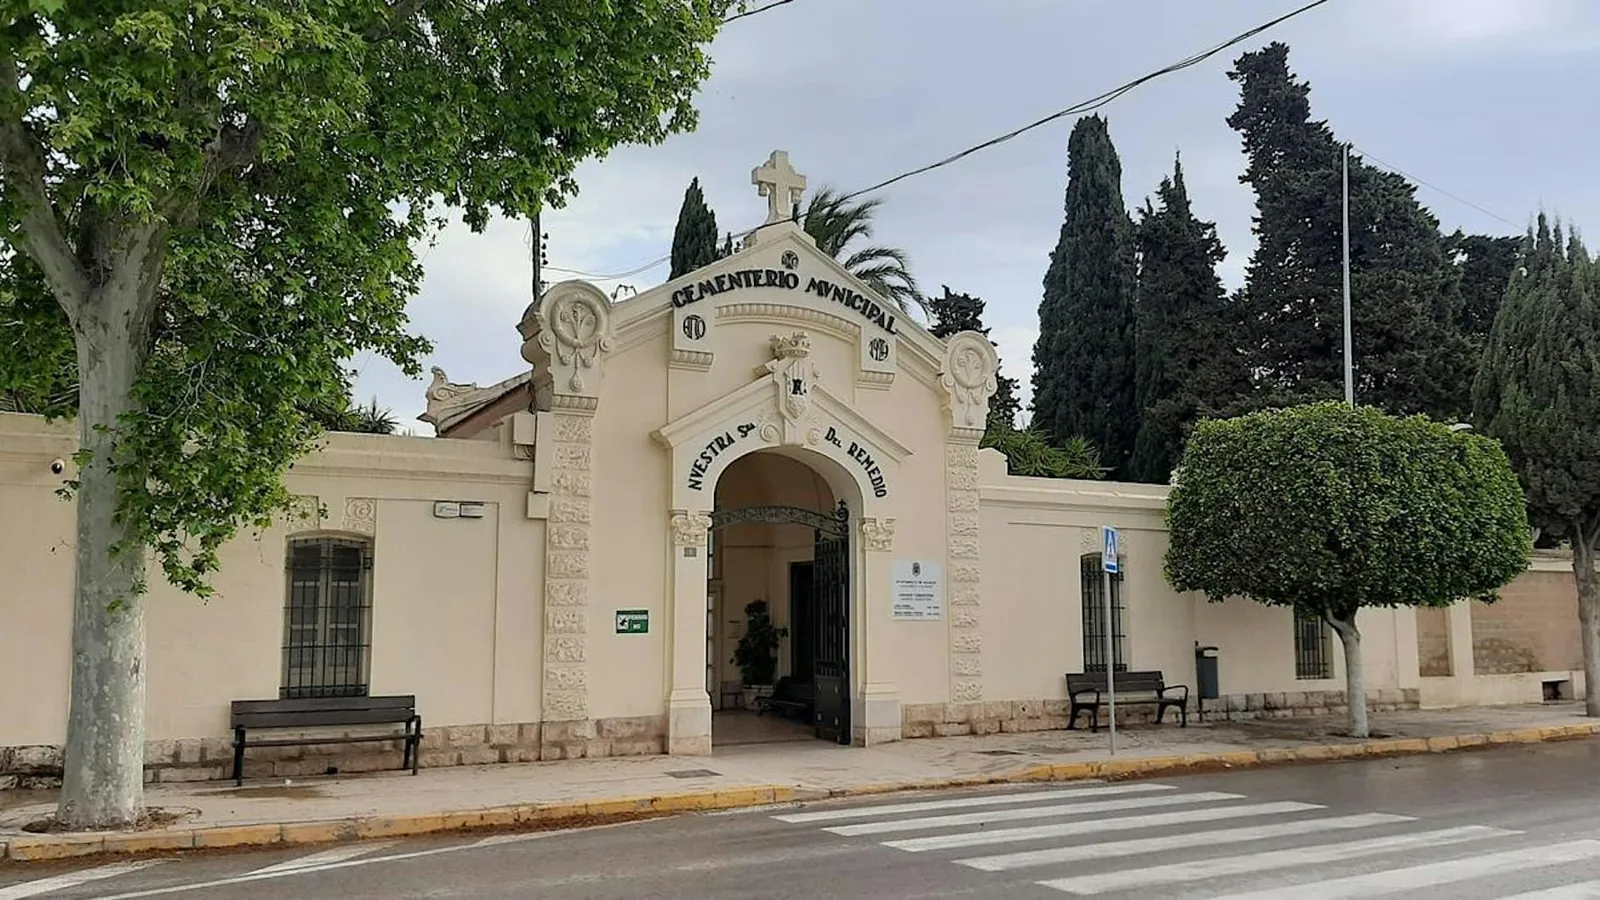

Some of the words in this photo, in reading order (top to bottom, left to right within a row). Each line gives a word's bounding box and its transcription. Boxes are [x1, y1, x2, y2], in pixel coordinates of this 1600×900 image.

[672, 269, 800, 308] CEMENTERIO
[805, 277, 897, 335] MVNICIPAL
[688, 431, 736, 491] NVESTRA
[847, 441, 887, 498] REMEDIO
